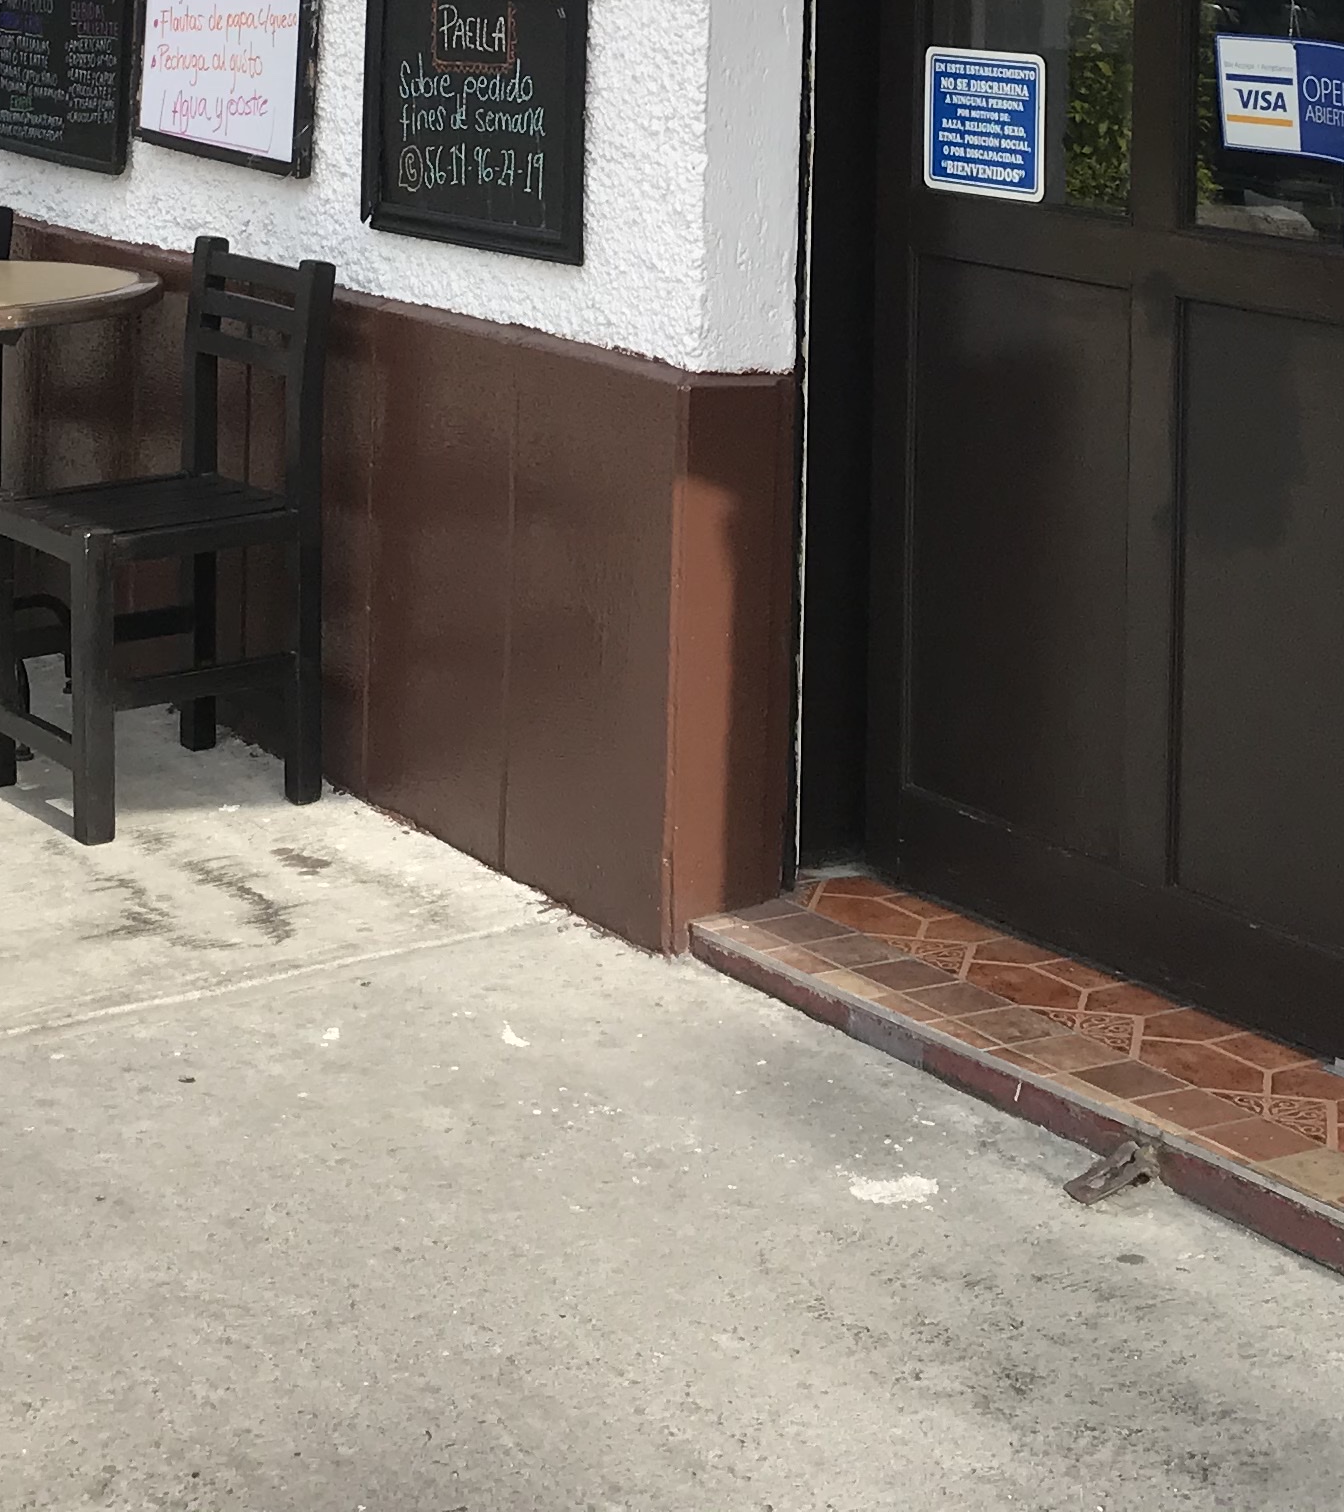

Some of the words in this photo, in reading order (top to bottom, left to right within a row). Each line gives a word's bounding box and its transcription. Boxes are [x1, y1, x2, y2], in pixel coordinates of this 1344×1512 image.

[160, 6, 206, 38] Flautas
[208, 4, 223, 31] de
[226, 12, 257, 45] papa
[438, 4, 506, 52] PAELLA
[157, 44, 210, 87] Pechuga
[211, 44, 226, 71] al
[229, 41, 263, 94] gusto
[936, 62, 947, 72] EN
[947, 63, 965, 74] ESTE
[966, 64, 1036, 81] ESTABLECIMIENTO
[399, 52, 455, 99] Sobre
[462, 58, 534, 118] pedido
[940, 76, 955, 89] NO
[956, 78, 969, 91] SE
[970, 80, 1029, 97] DISCRIMINA
[171, 90, 212, 133] Agua
[212, 96, 224, 133] y
[225, 88, 269, 136] postre
[945, 94, 952, 104] A
[952, 94, 988, 108] NINGUNA
[988, 98, 1024, 112] PERSONA
[1233, 88, 1287, 113] VISA
[399, 104, 447, 142] fines
[450, 94, 468, 130] de
[475, 106, 546, 138] semana
[941, 118, 964, 131] RAZA,
[1003, 124, 1027, 138] SEXO,
[942, 145, 949, 155] O
[949, 146, 965, 158] POR
[964, 134, 999, 147] POSICIÓN
[1000, 138, 1032, 153] SOCIAL,
